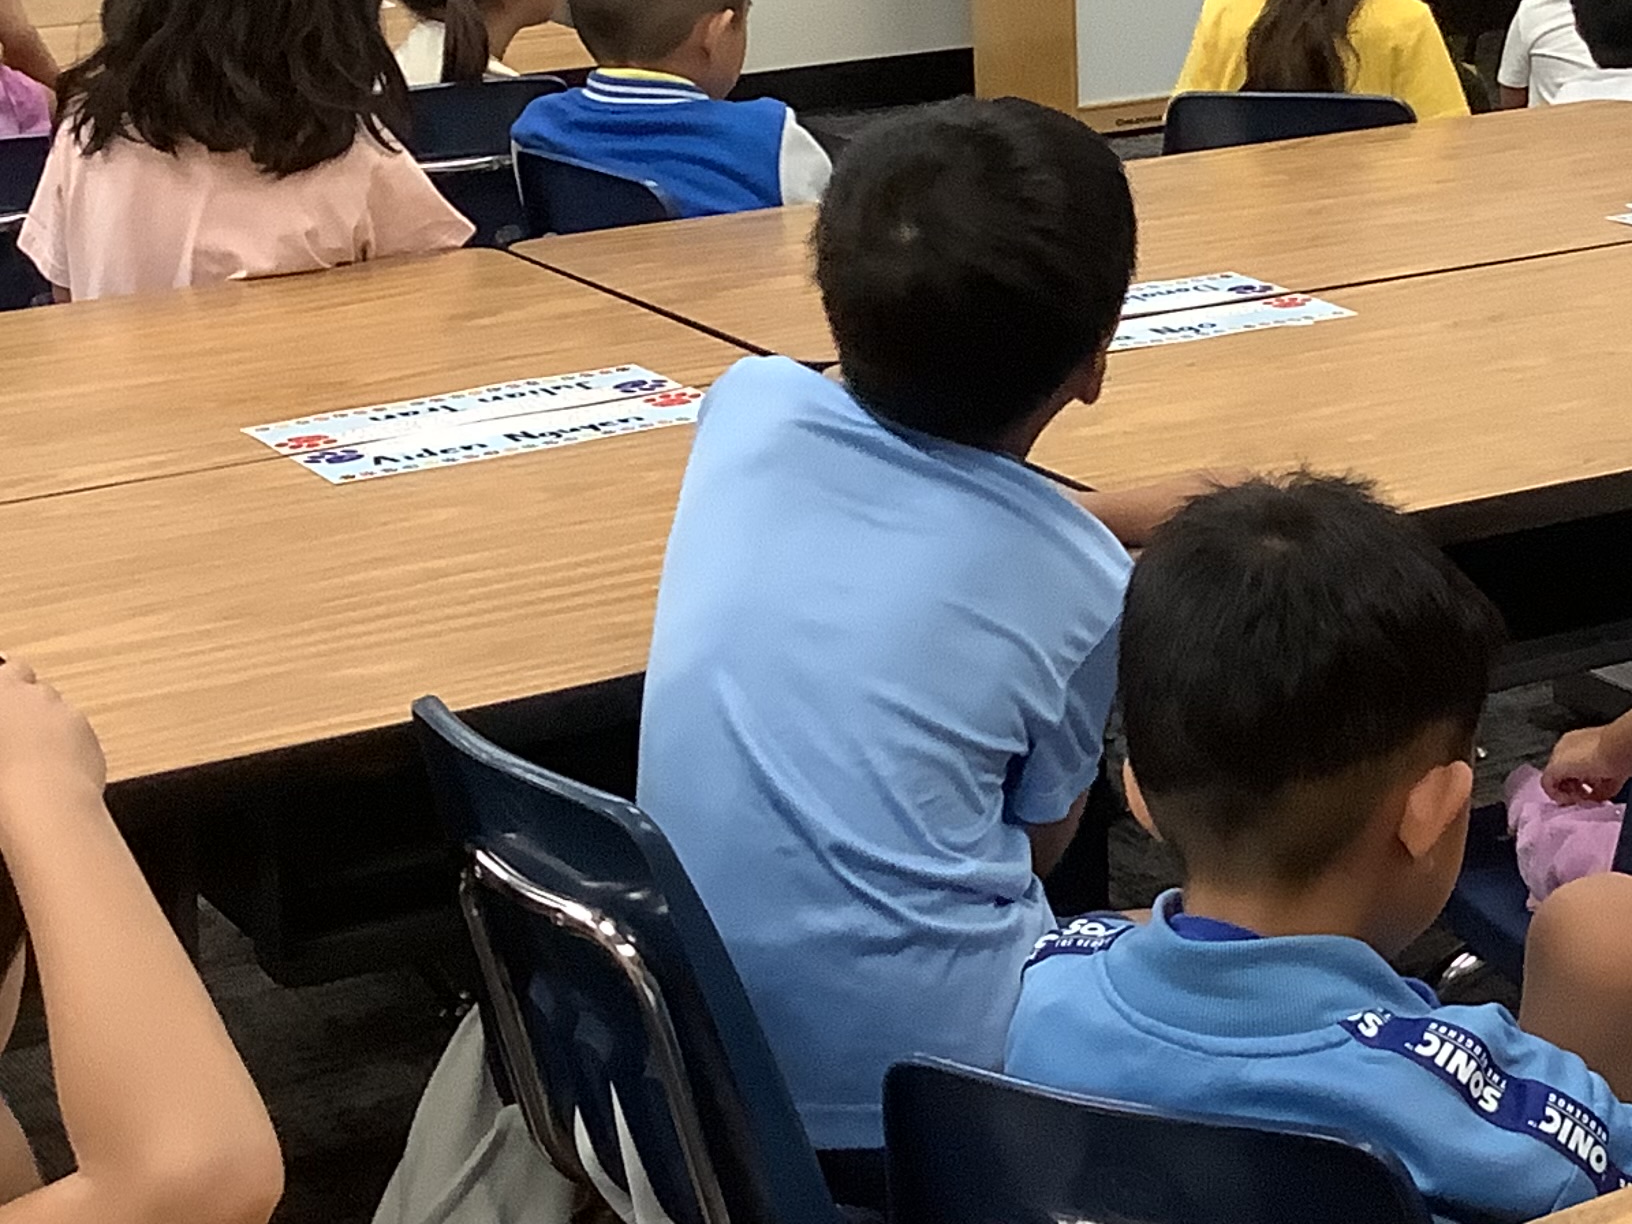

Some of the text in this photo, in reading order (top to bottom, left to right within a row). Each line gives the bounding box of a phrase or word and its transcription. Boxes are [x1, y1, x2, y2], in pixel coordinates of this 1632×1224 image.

[503, 416, 645, 442] Nguyen
[1414, 1031, 1503, 1114] SONIC
[1487, 1067, 1507, 1090] THE
[1538, 1105, 1608, 1174] ONIC
